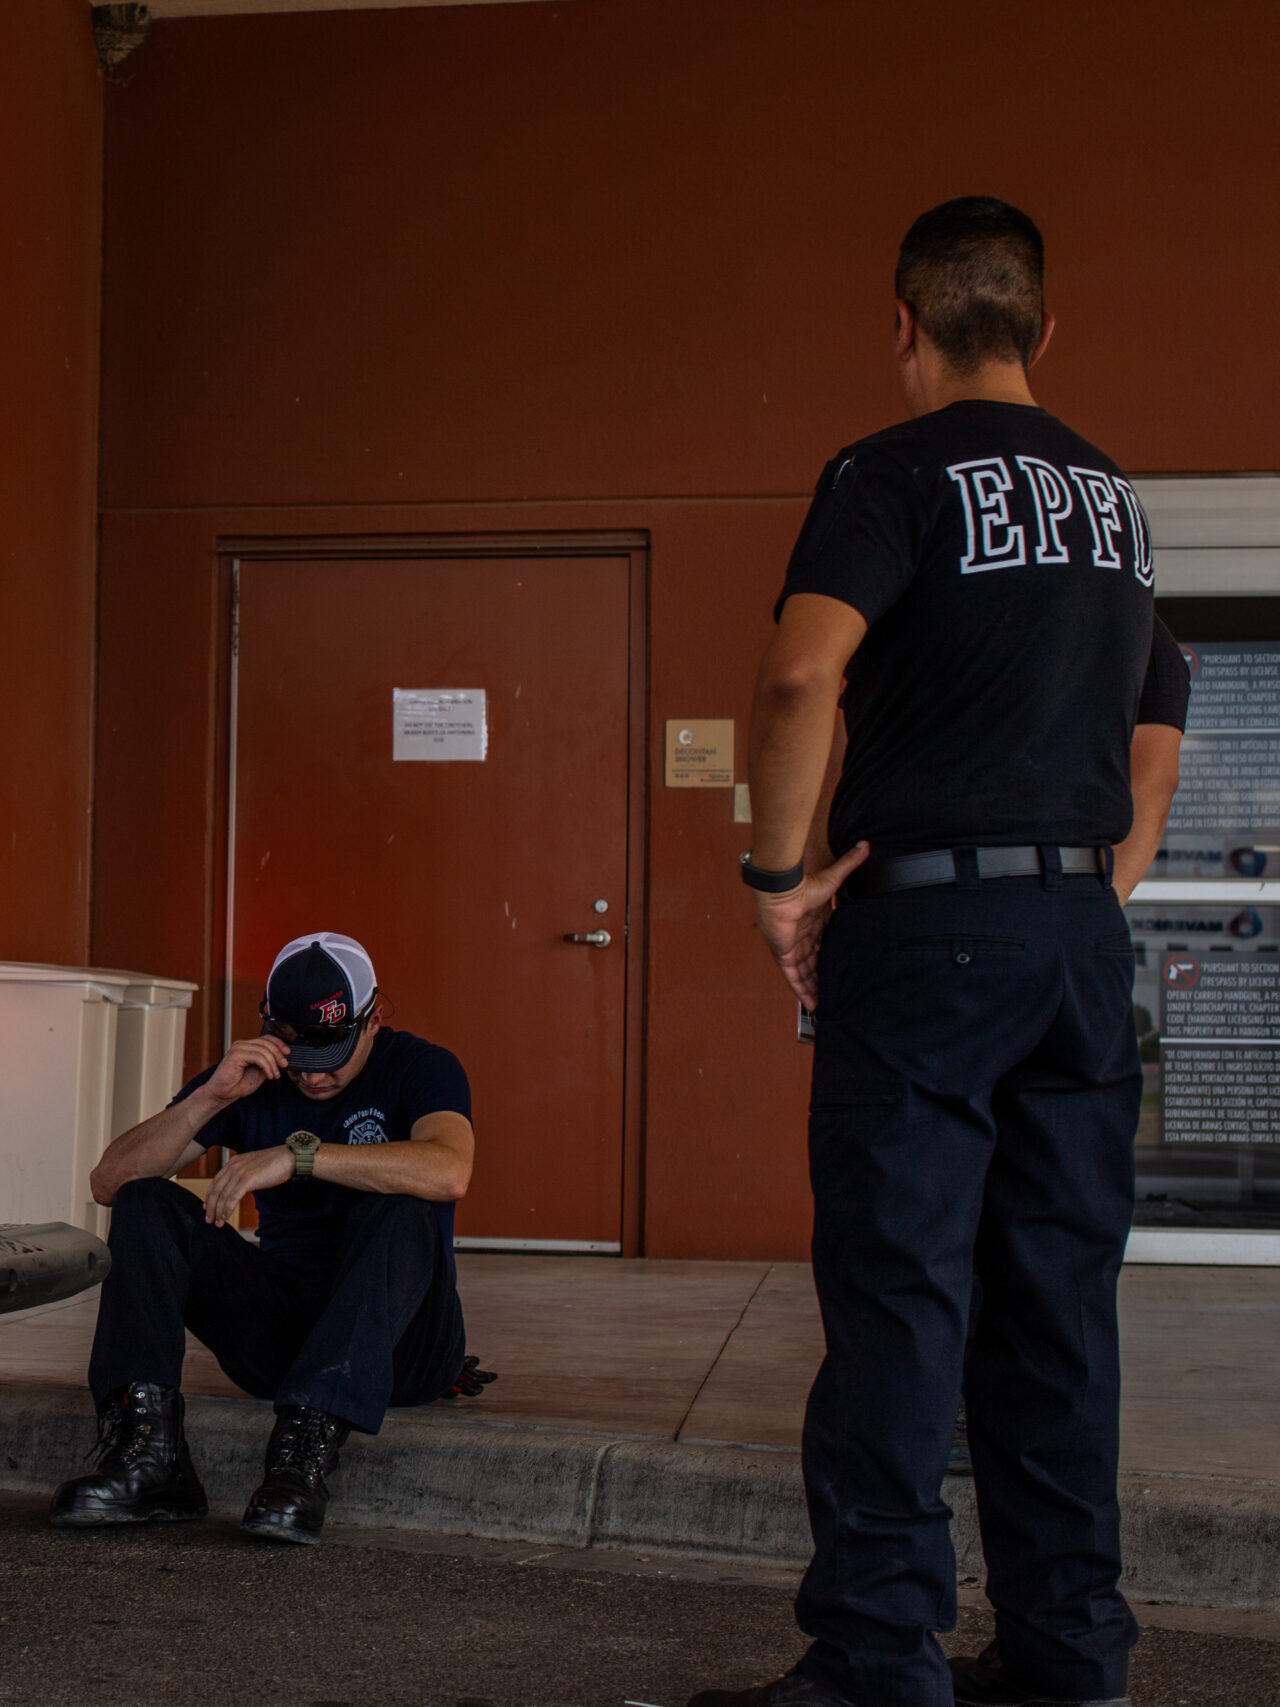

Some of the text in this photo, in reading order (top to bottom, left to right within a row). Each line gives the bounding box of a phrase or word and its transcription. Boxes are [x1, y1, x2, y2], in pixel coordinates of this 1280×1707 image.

[1244, 654, 1252, 663] TO
[1240, 666, 1249, 676] BY
[1251, 666, 1278, 676] LICENSE
[1252, 680, 1257, 689] A
[1240, 718, 1245, 727] A
[1241, 963, 1250, 972] TO
[1251, 963, 1279, 972] SECTION
[1238, 977, 1247, 986] BY
[1248, 977, 1275, 986] LICENSE
[1166, 990, 1192, 1000] OPENLY
[1264, 990, 1270, 1000] A
[1167, 1002, 1191, 1012] UNDER
[320, 1000, 346, 1024] FD
[1166, 1014, 1184, 1024] CODE
[1183, 1026, 1214, 1035] PROPERTY
[1215, 1026, 1231, 1035] WITH
[1233, 1026, 1238, 1035] A
